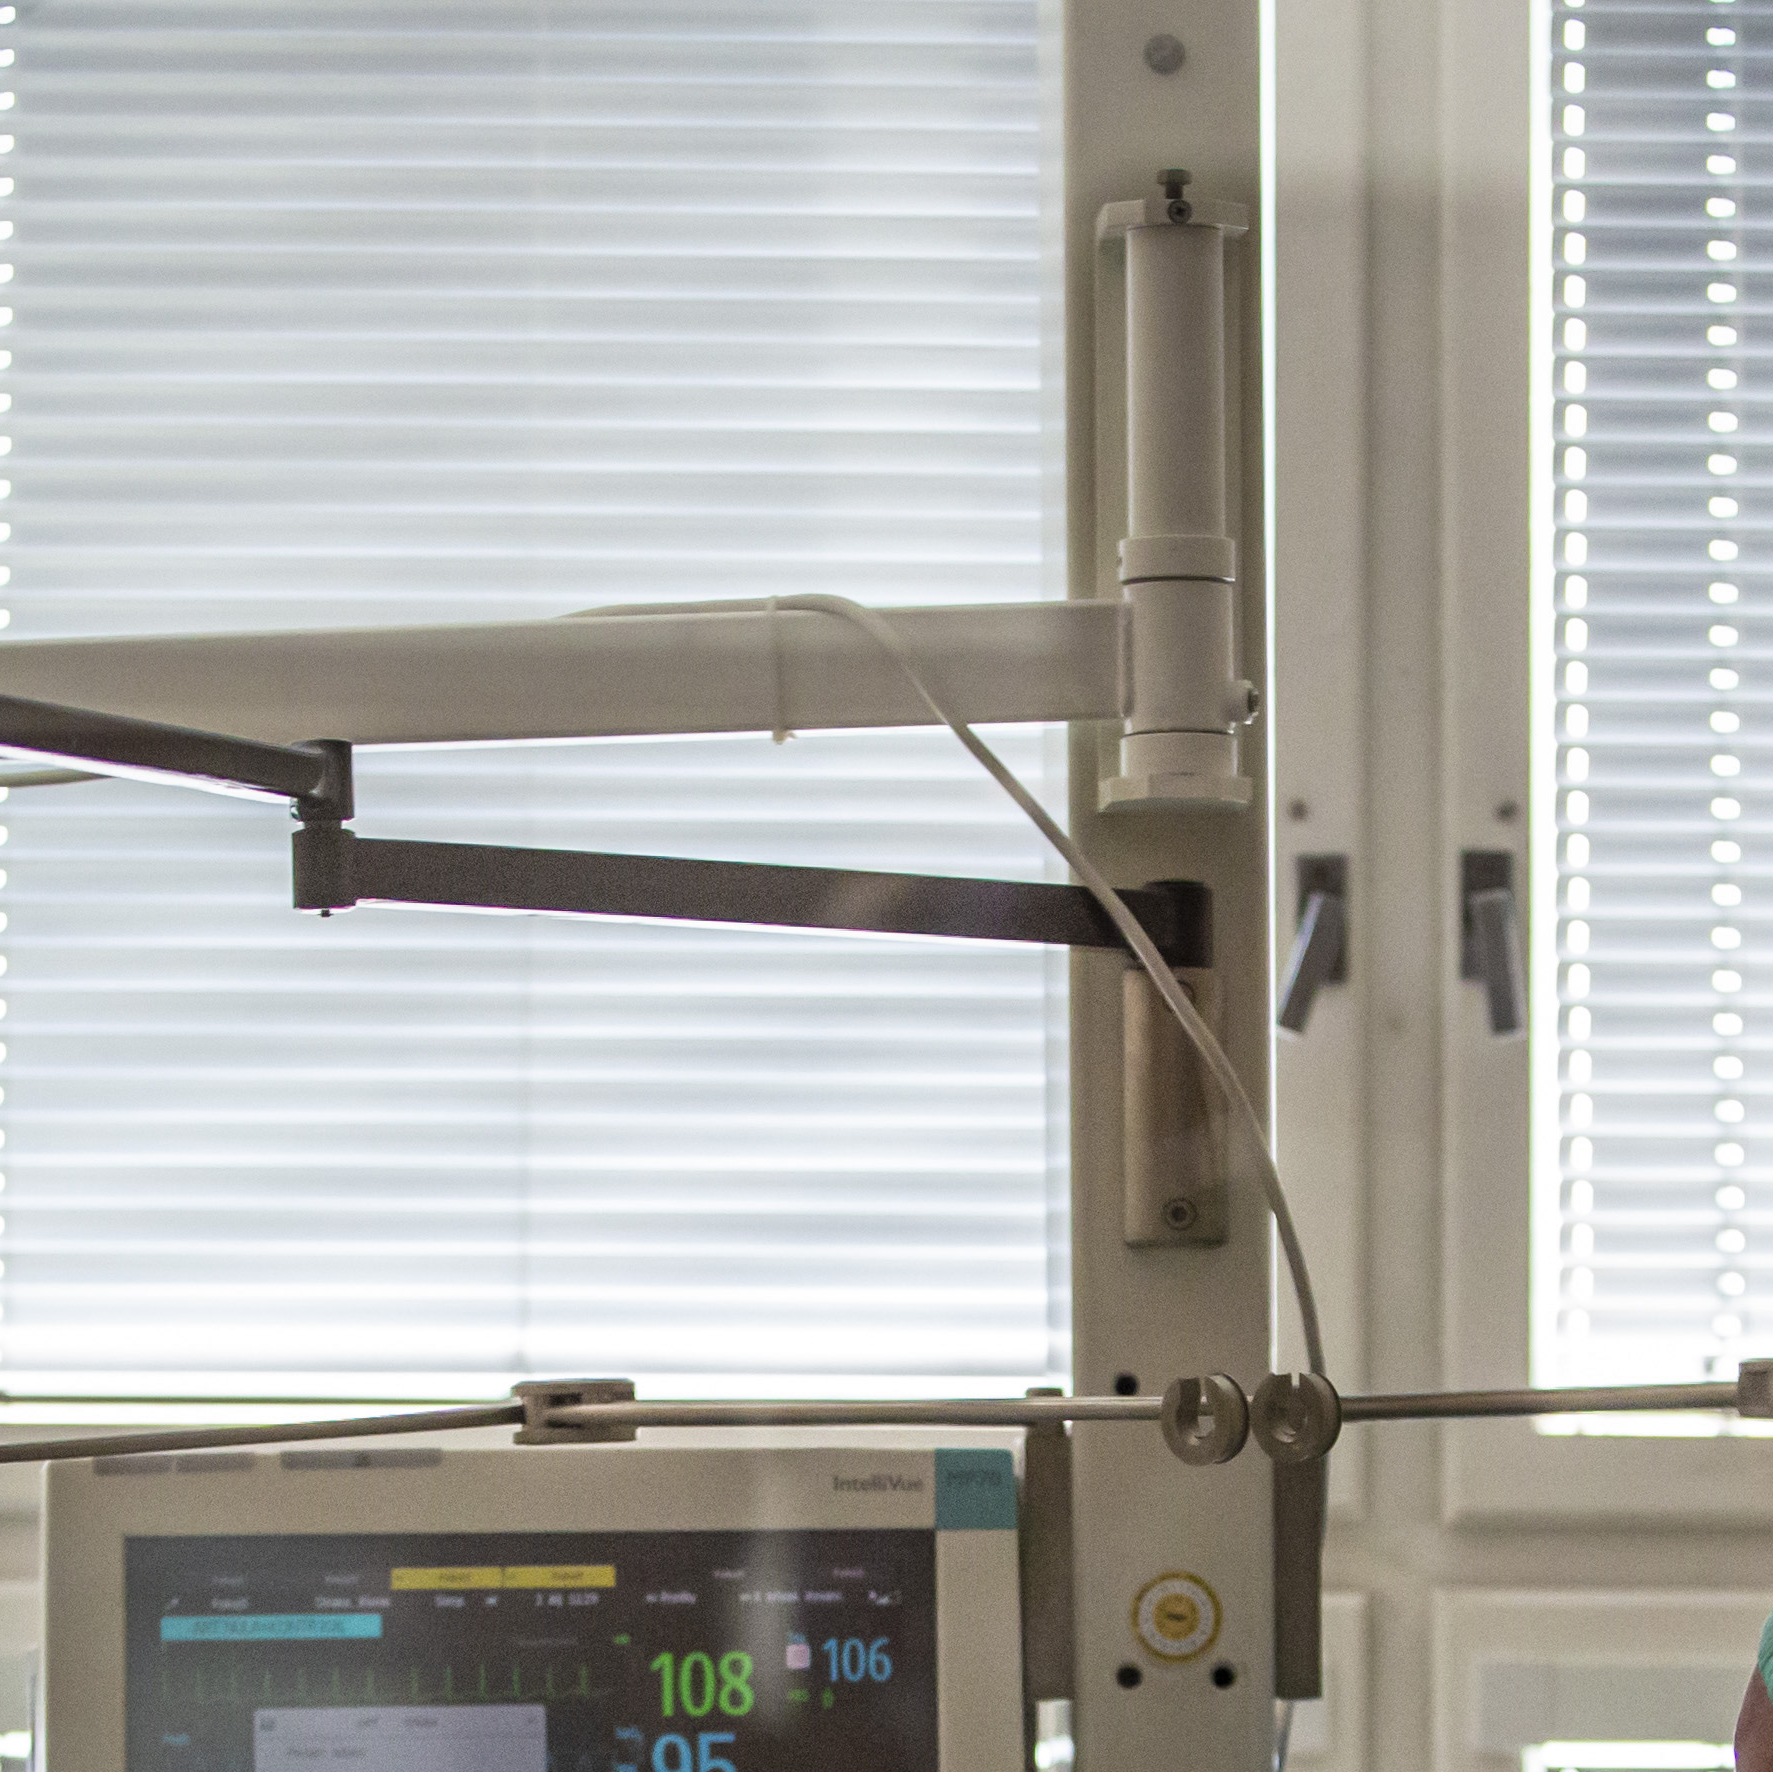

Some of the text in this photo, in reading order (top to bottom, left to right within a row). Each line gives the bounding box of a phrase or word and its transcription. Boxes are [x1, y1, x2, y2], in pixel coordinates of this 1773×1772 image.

[832, 1474, 923, 1492] IntelliVue
[822, 1637, 893, 1682] 106
[650, 1651, 754, 1717] 108
